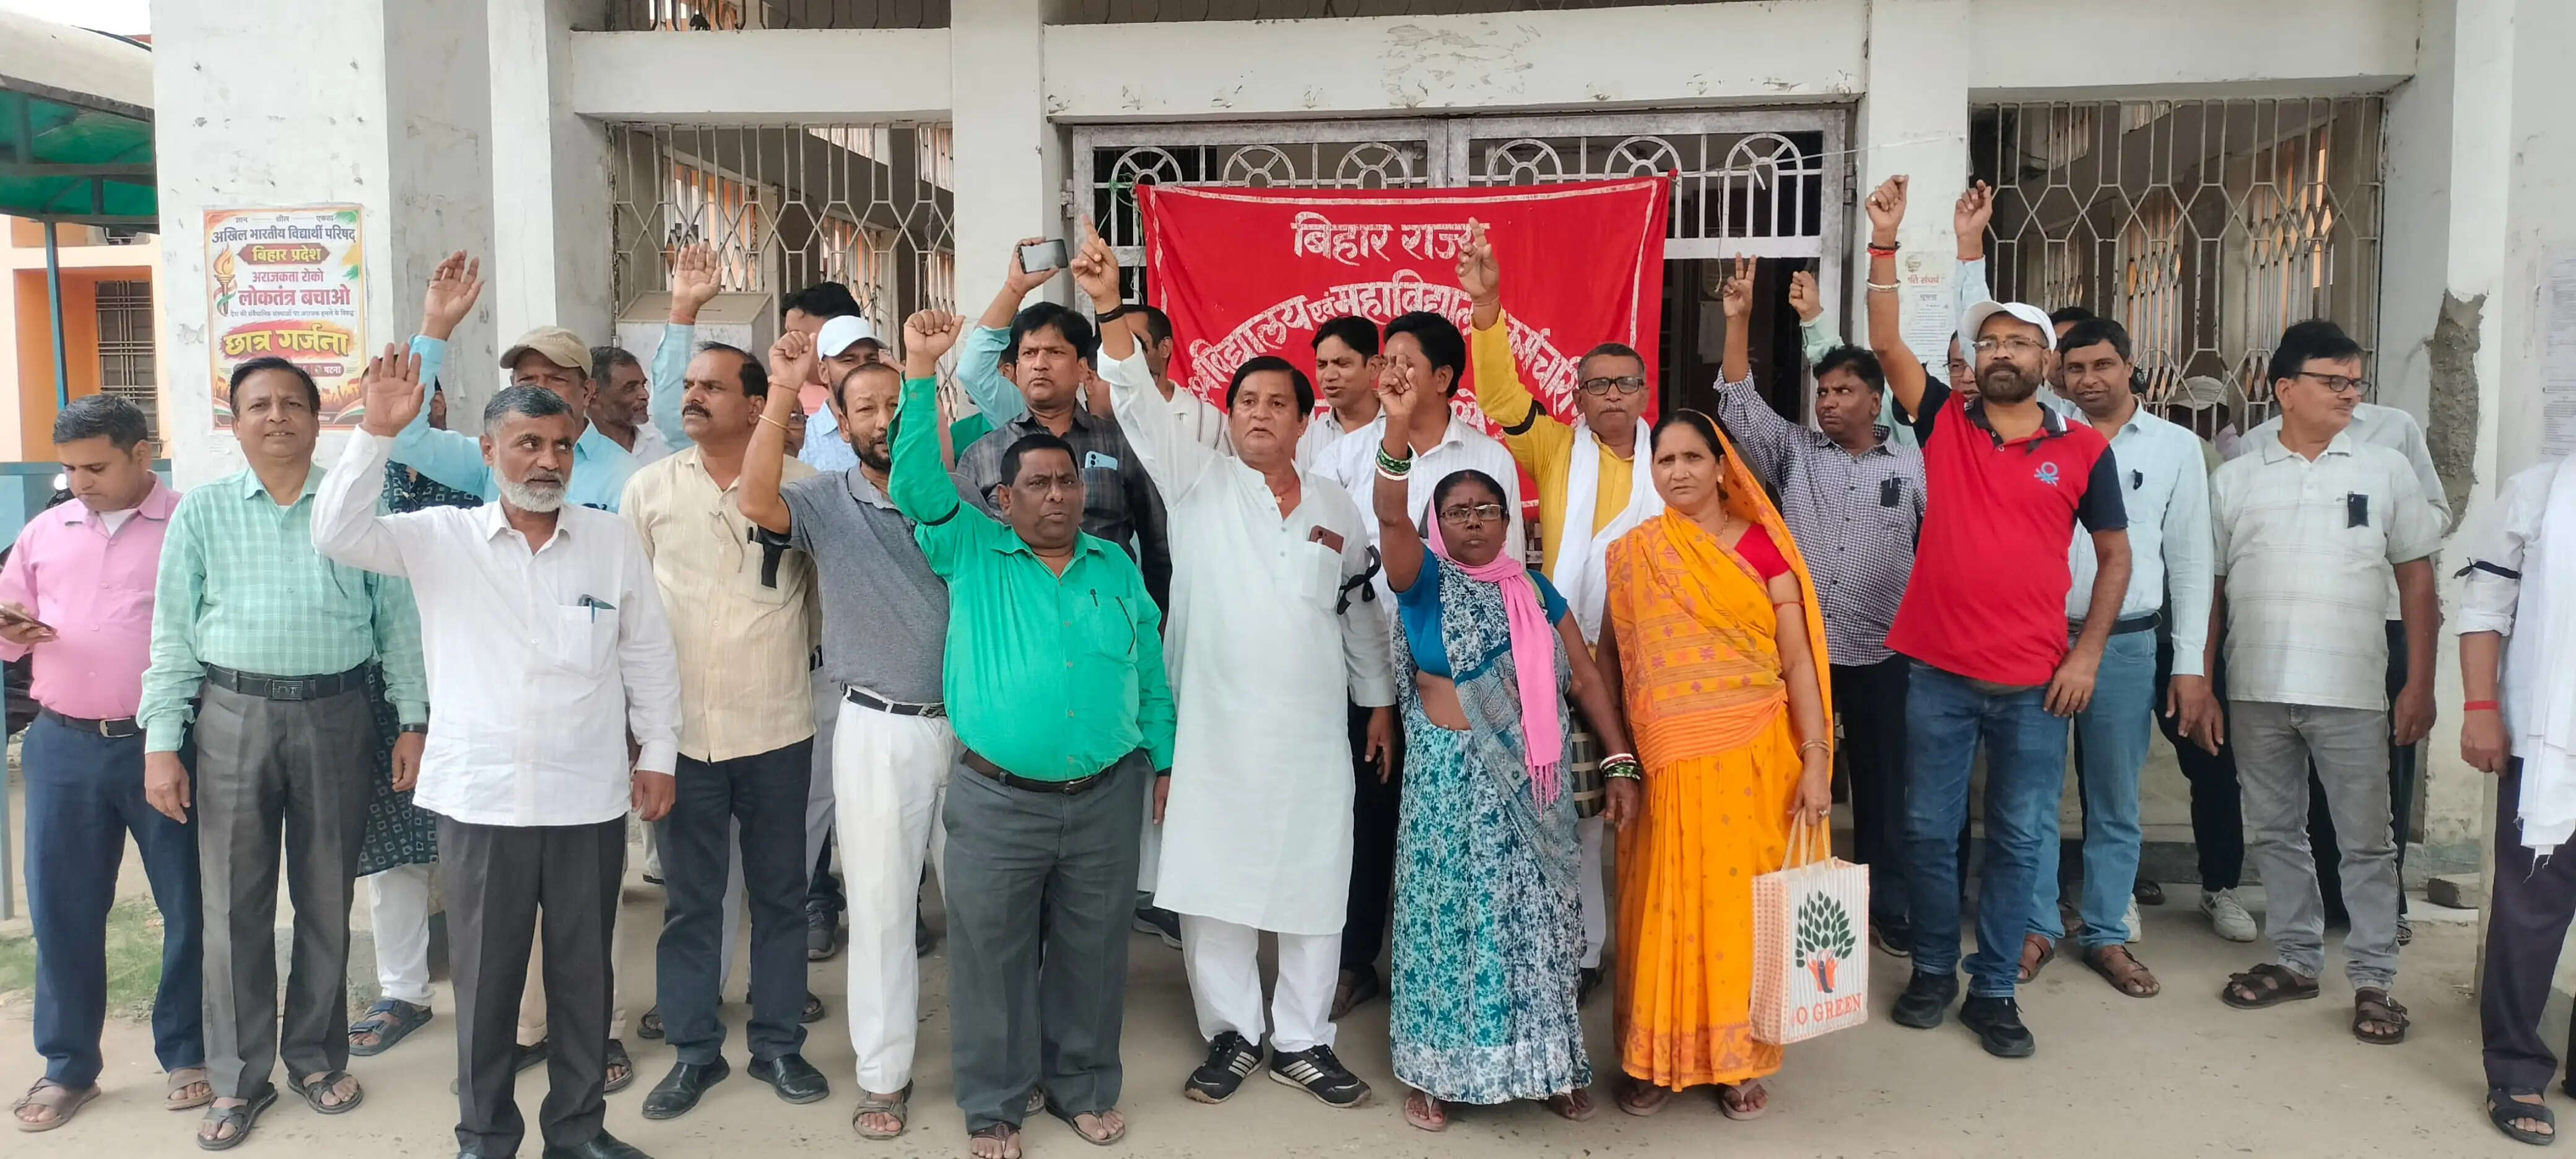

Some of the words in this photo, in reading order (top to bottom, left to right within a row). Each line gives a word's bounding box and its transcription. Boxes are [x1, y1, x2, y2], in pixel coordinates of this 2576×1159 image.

[212, 227, 248, 243] अखिल
[250, 225, 285, 240] भारतीय
[289, 225, 323, 240] विद्यार्थी
[325, 225, 356, 243] परिषद्
[1290, 211, 1394, 266] बिहार
[252, 246, 287, 262] बिहार
[291, 246, 322, 262] प्रदेश
[253, 271, 300, 283] अराजकता
[302, 268, 324, 282] रोको
[238, 284, 297, 306] लोकतंत्र
[300, 284, 351, 305] बचाओ
[1307, 291, 1336, 323] एवं
[1329, 268, 1473, 336] महाविद्याल
[224, 330, 272, 356] छात्र
[276, 323, 350, 357] गर्जना
[323, 365, 342, 374] पटना
[1813, 992, 1861, 1022] GREEN
